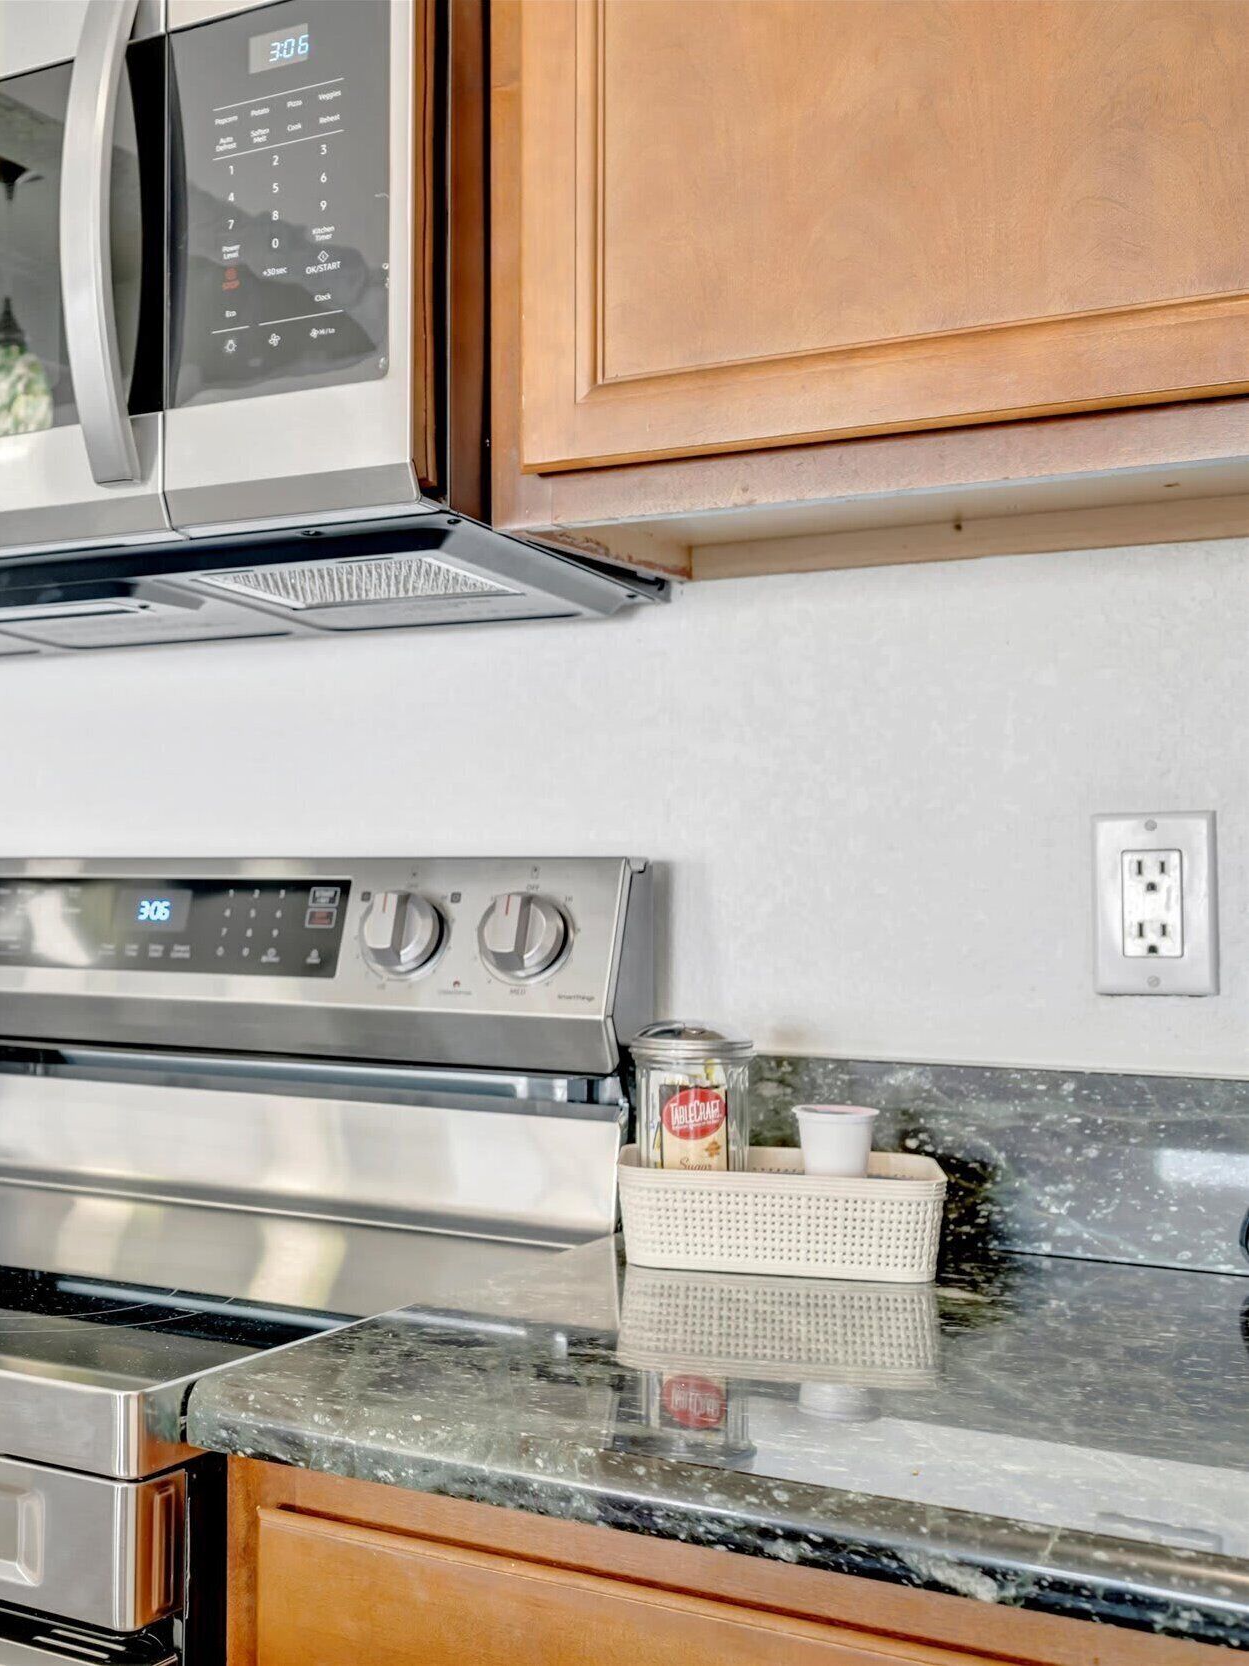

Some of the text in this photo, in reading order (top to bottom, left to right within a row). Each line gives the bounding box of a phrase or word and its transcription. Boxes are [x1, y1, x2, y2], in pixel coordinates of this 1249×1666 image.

[269, 34, 309, 62] 3:06
[318, 90, 342, 101] Veggies
[250, 107, 270, 116] Potato
[214, 115, 238, 125] Popcorn
[319, 114, 340, 124] Reheat
[287, 123, 302, 132] Cook
[320, 144, 328, 155] 3
[272, 155, 280, 166] 2
[229, 165, 235, 175] 1
[320, 172, 328, 183] 6
[272, 183, 280, 193] 5
[227, 192, 235, 202] 4
[320, 200, 328, 211] 9
[272, 210, 280, 221] 8
[228, 219, 236, 230] 7
[312, 225, 335, 235] Kitchen
[315, 233, 333, 241] Timer
[271, 238, 280, 248] 0
[305, 261, 341, 274] OK/START
[314, 293, 332, 302] Clock
